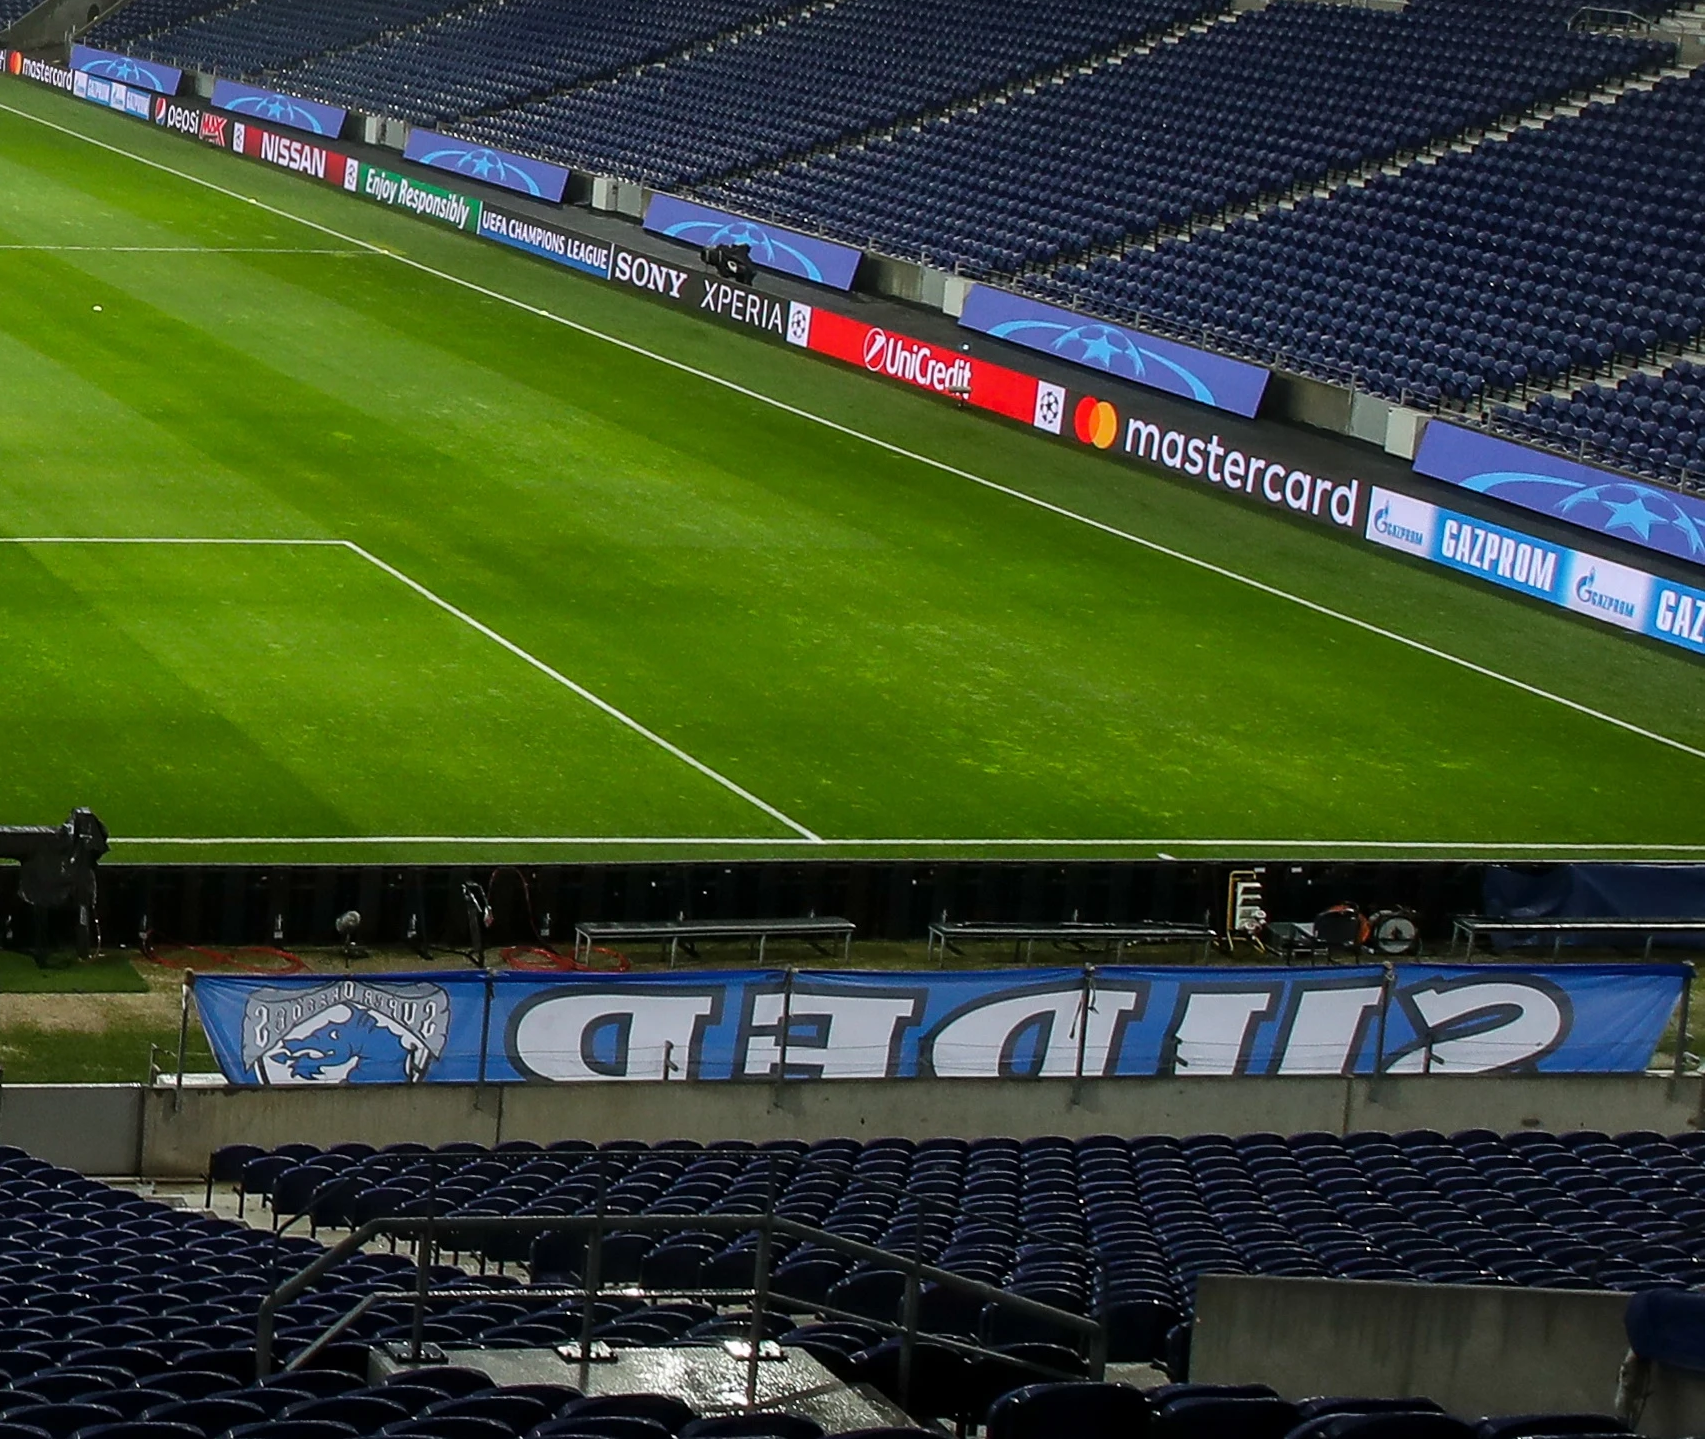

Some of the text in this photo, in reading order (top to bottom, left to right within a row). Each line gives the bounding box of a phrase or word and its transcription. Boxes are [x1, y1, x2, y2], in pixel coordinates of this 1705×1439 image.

[22, 57, 73, 91] mastercard
[167, 104, 200, 135] pepsi
[261, 130, 326, 179] NISSAN
[365, 167, 470, 230] Enjoy Responsibly
[482, 209, 608, 271] UEFA CHAMPIONS LEAGUE
[614, 250, 784, 335] SONY XPERIA
[886, 334, 971, 399] UniCredit
[1125, 415, 1358, 528] mastercard
[1386, 521, 1424, 547] GAZPROM
[1441, 518, 1557, 592] GAZPROM
[1591, 591, 1636, 619] GAZPROM
